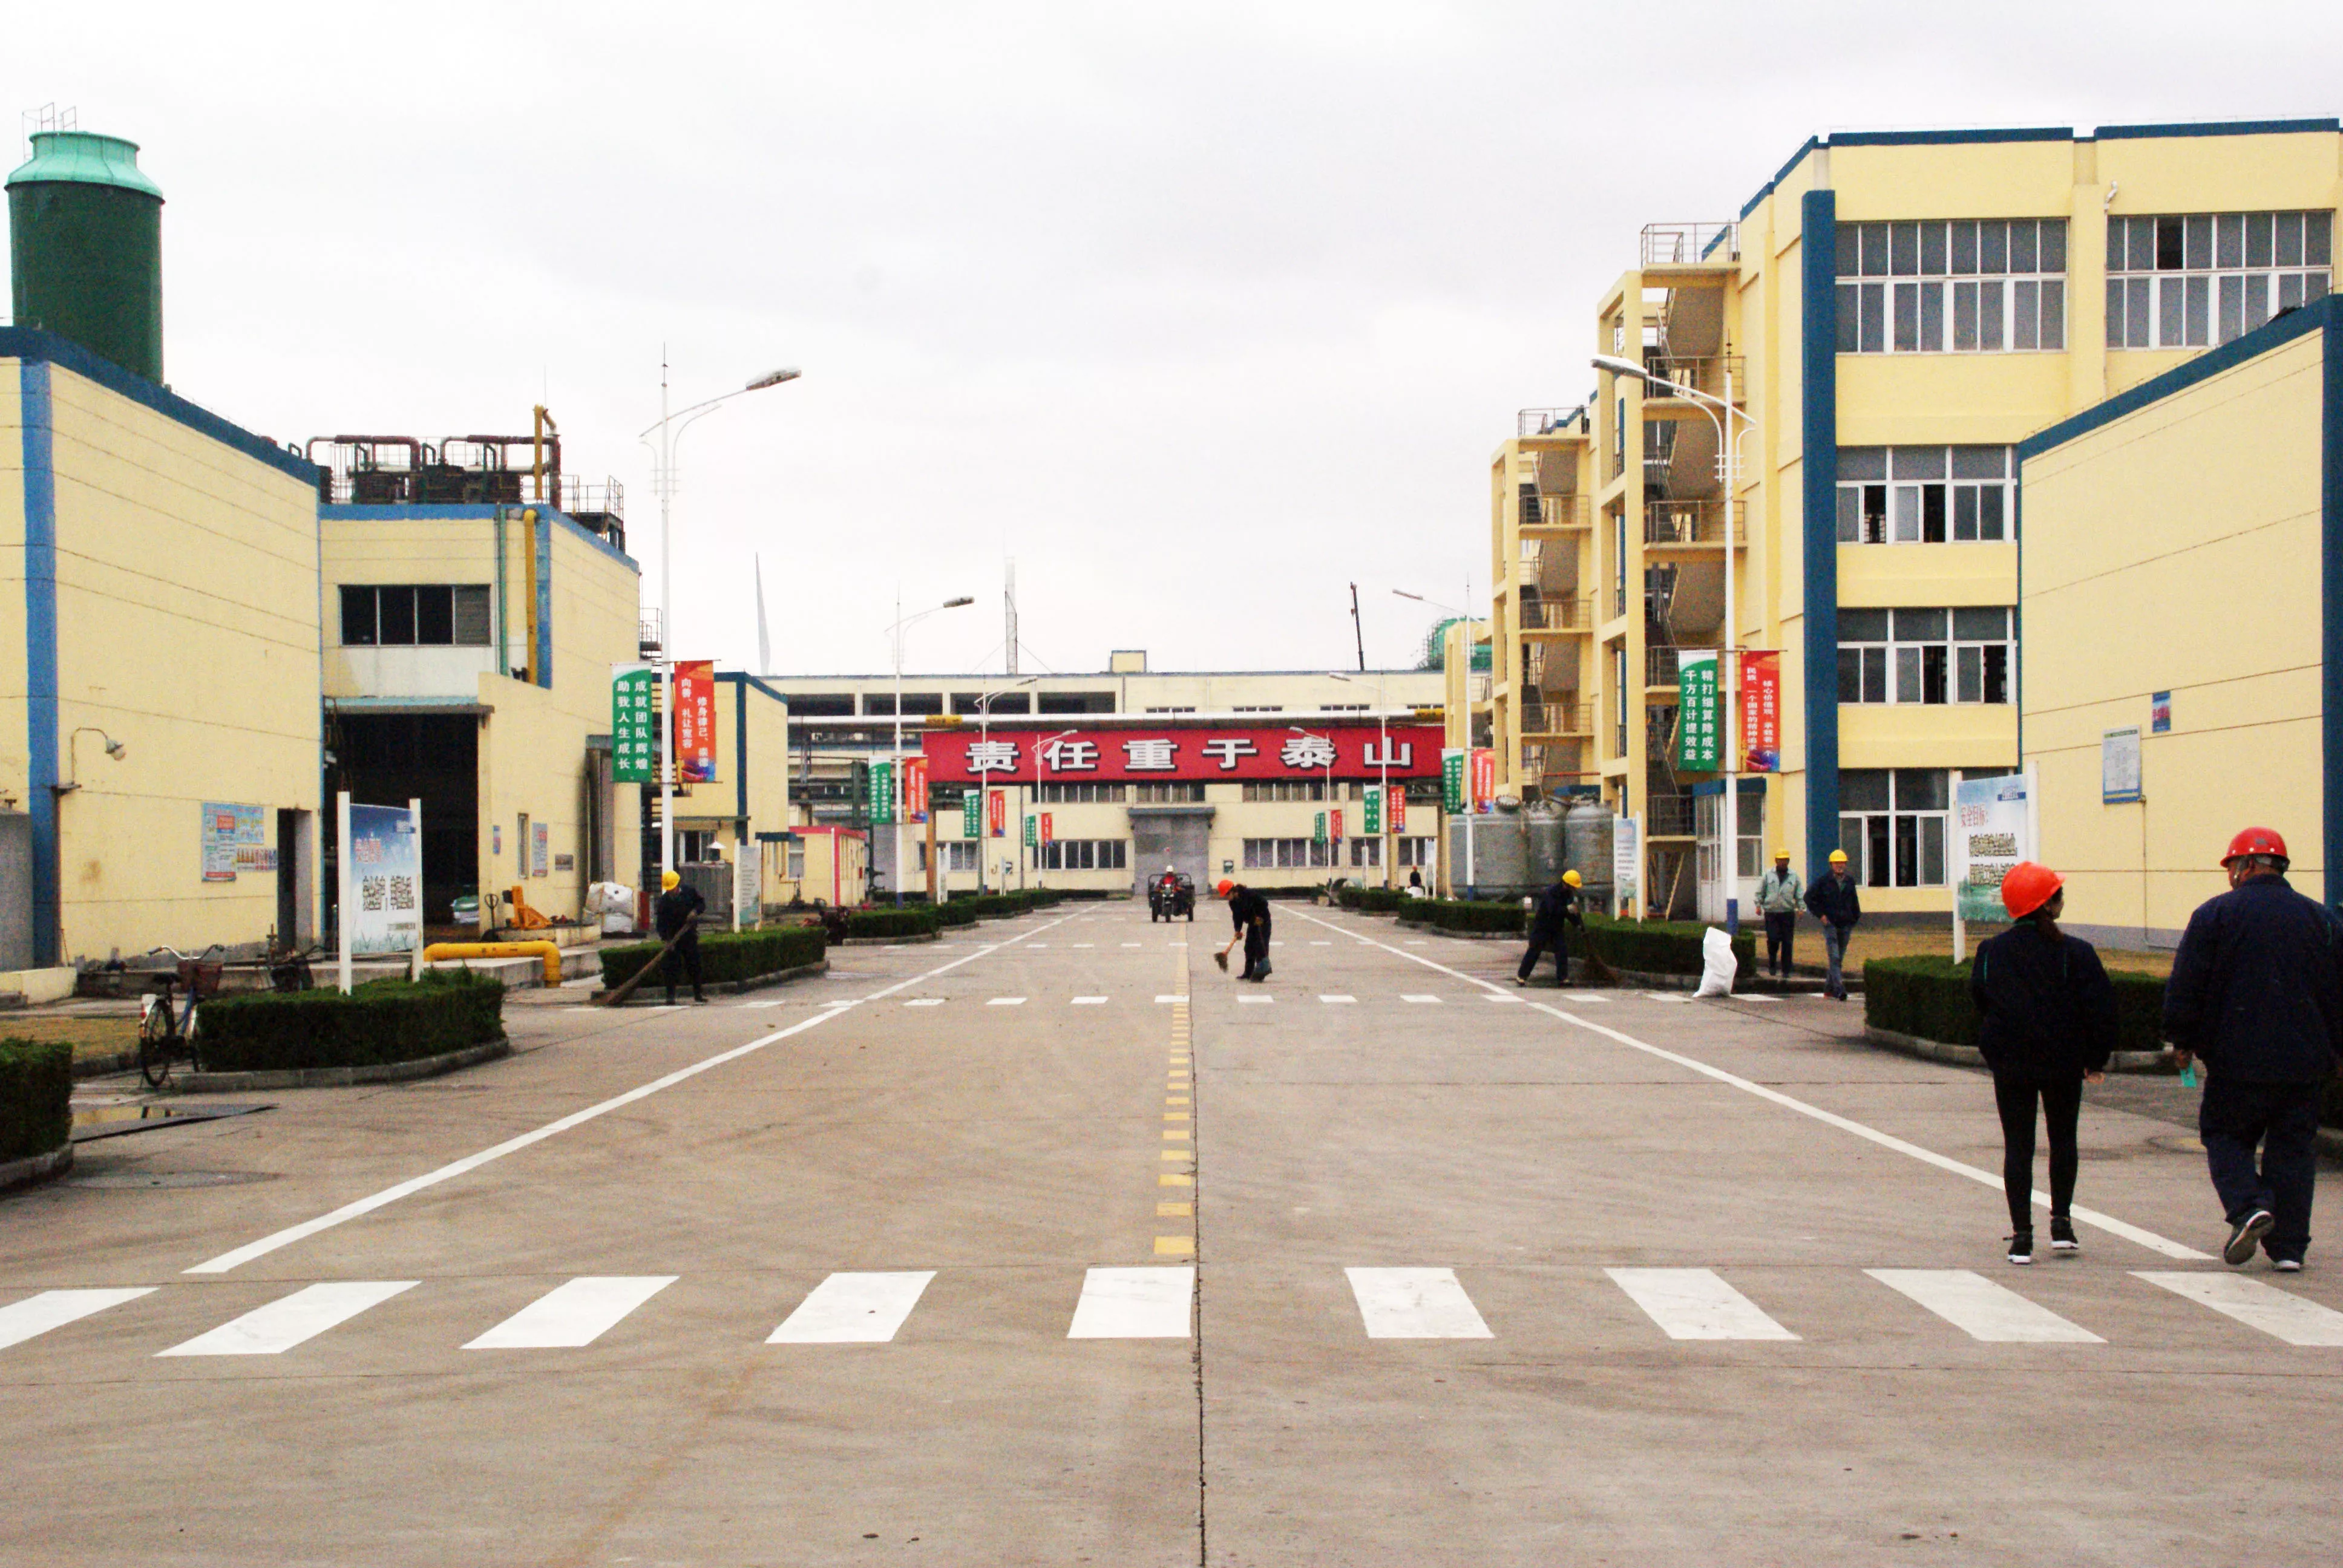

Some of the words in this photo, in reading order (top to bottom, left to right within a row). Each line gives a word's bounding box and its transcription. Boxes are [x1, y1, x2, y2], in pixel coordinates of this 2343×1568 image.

[617, 681, 631, 770] 助我人生成长
[635, 681, 648, 770] 成就团队辉煌
[966, 737, 1412, 772] 责任重于泰山
[1685, 670, 1697, 760] 千方百计提效益
[1701, 670, 1714, 761] 精打细算降成本
